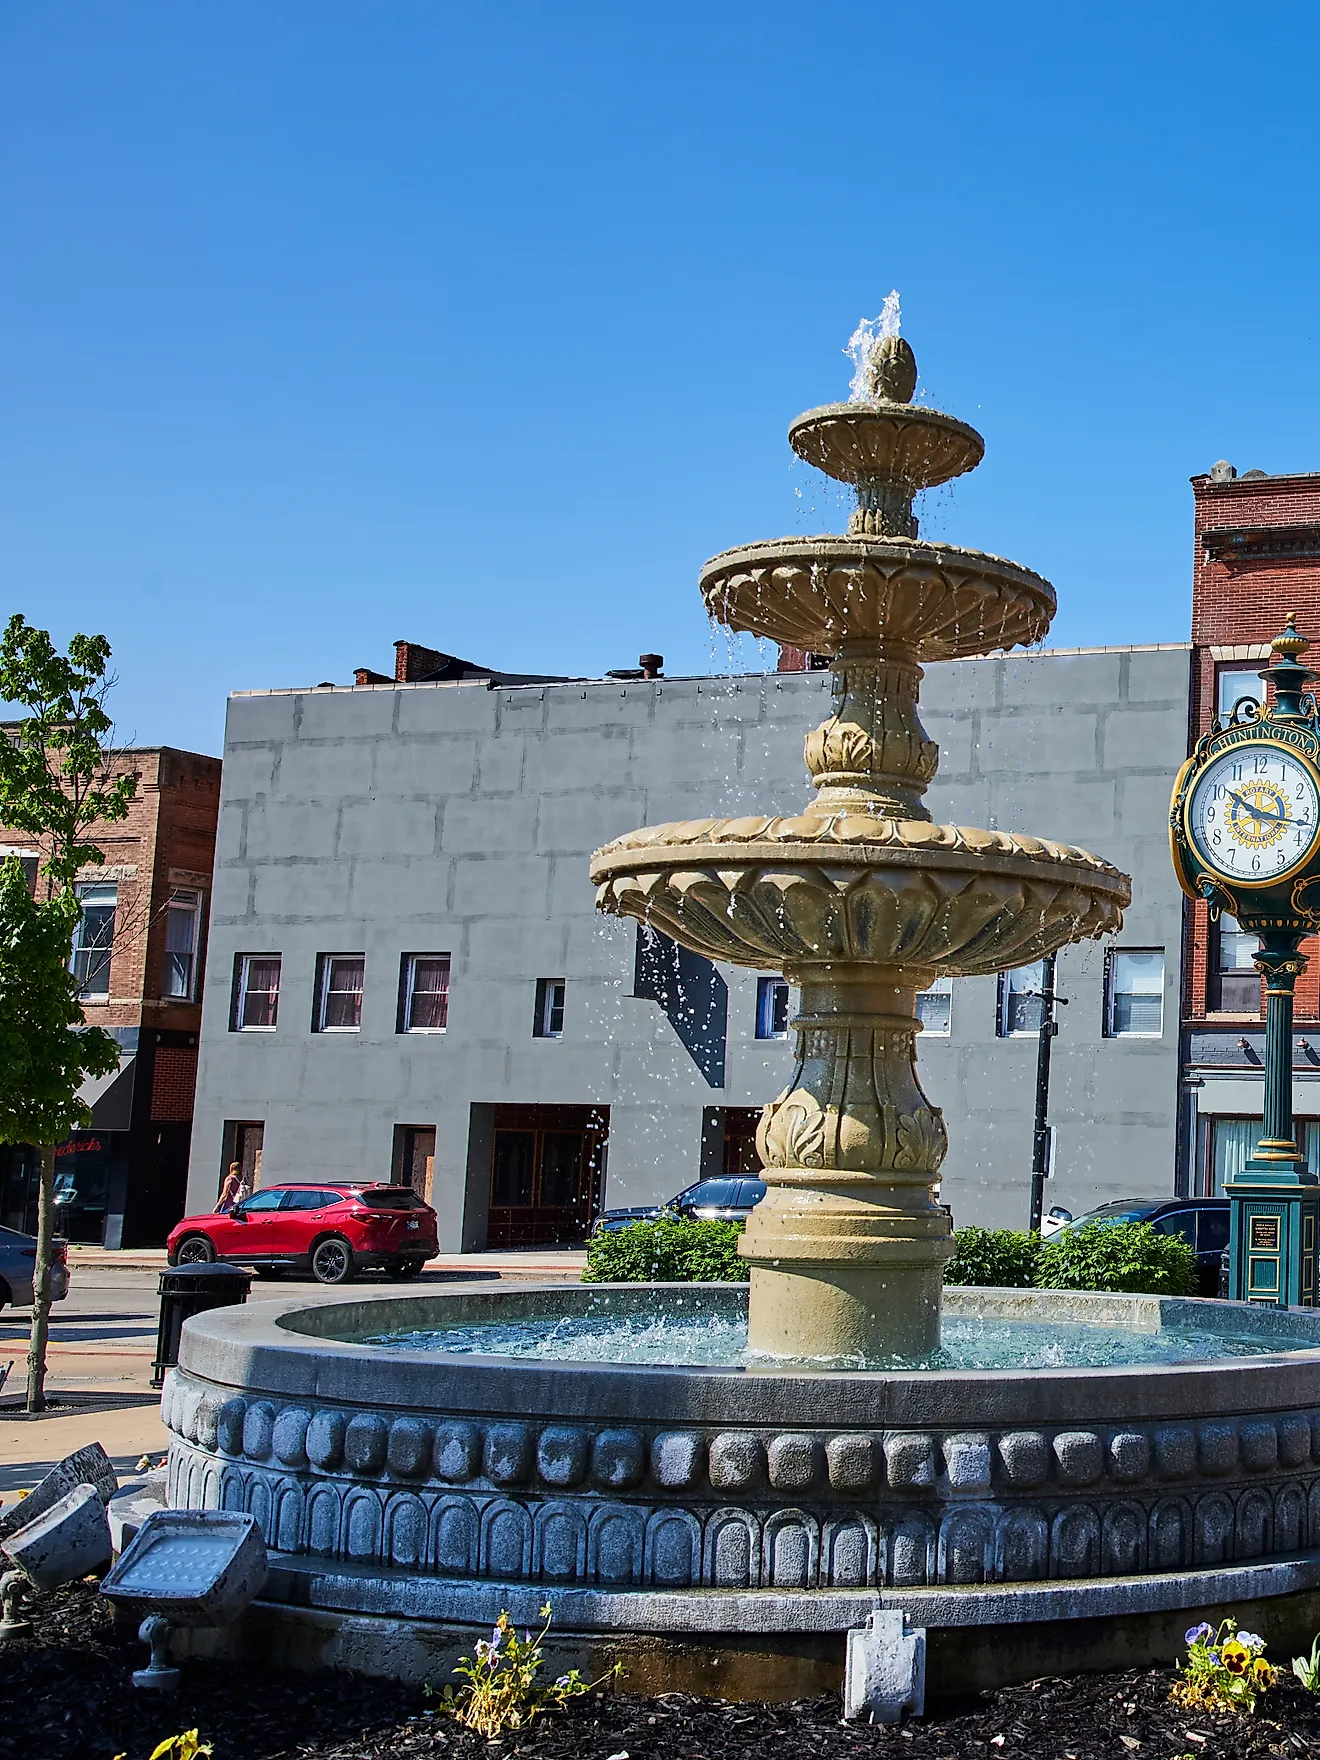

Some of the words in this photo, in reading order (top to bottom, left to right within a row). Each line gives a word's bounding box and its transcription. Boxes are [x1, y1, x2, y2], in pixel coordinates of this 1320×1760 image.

[1218, 726, 1309, 750] HUNTINGTON
[1231, 764, 1243, 782] 11
[1253, 756, 1268, 775] 12
[1281, 764, 1286, 782] 1
[1212, 783, 1226, 801] 10
[1244, 786, 1274, 797] ROTARY
[1295, 782, 1305, 801] 2
[1207, 806, 1216, 824] 9
[1302, 806, 1310, 824] 3
[1212, 828, 1222, 846] 8
[1234, 822, 1282, 843] INTERNATIONAL
[1292, 830, 1303, 847] 4
[1226, 848, 1236, 866] 7
[1251, 854, 1261, 872] 6
[1276, 849, 1286, 866] 5
